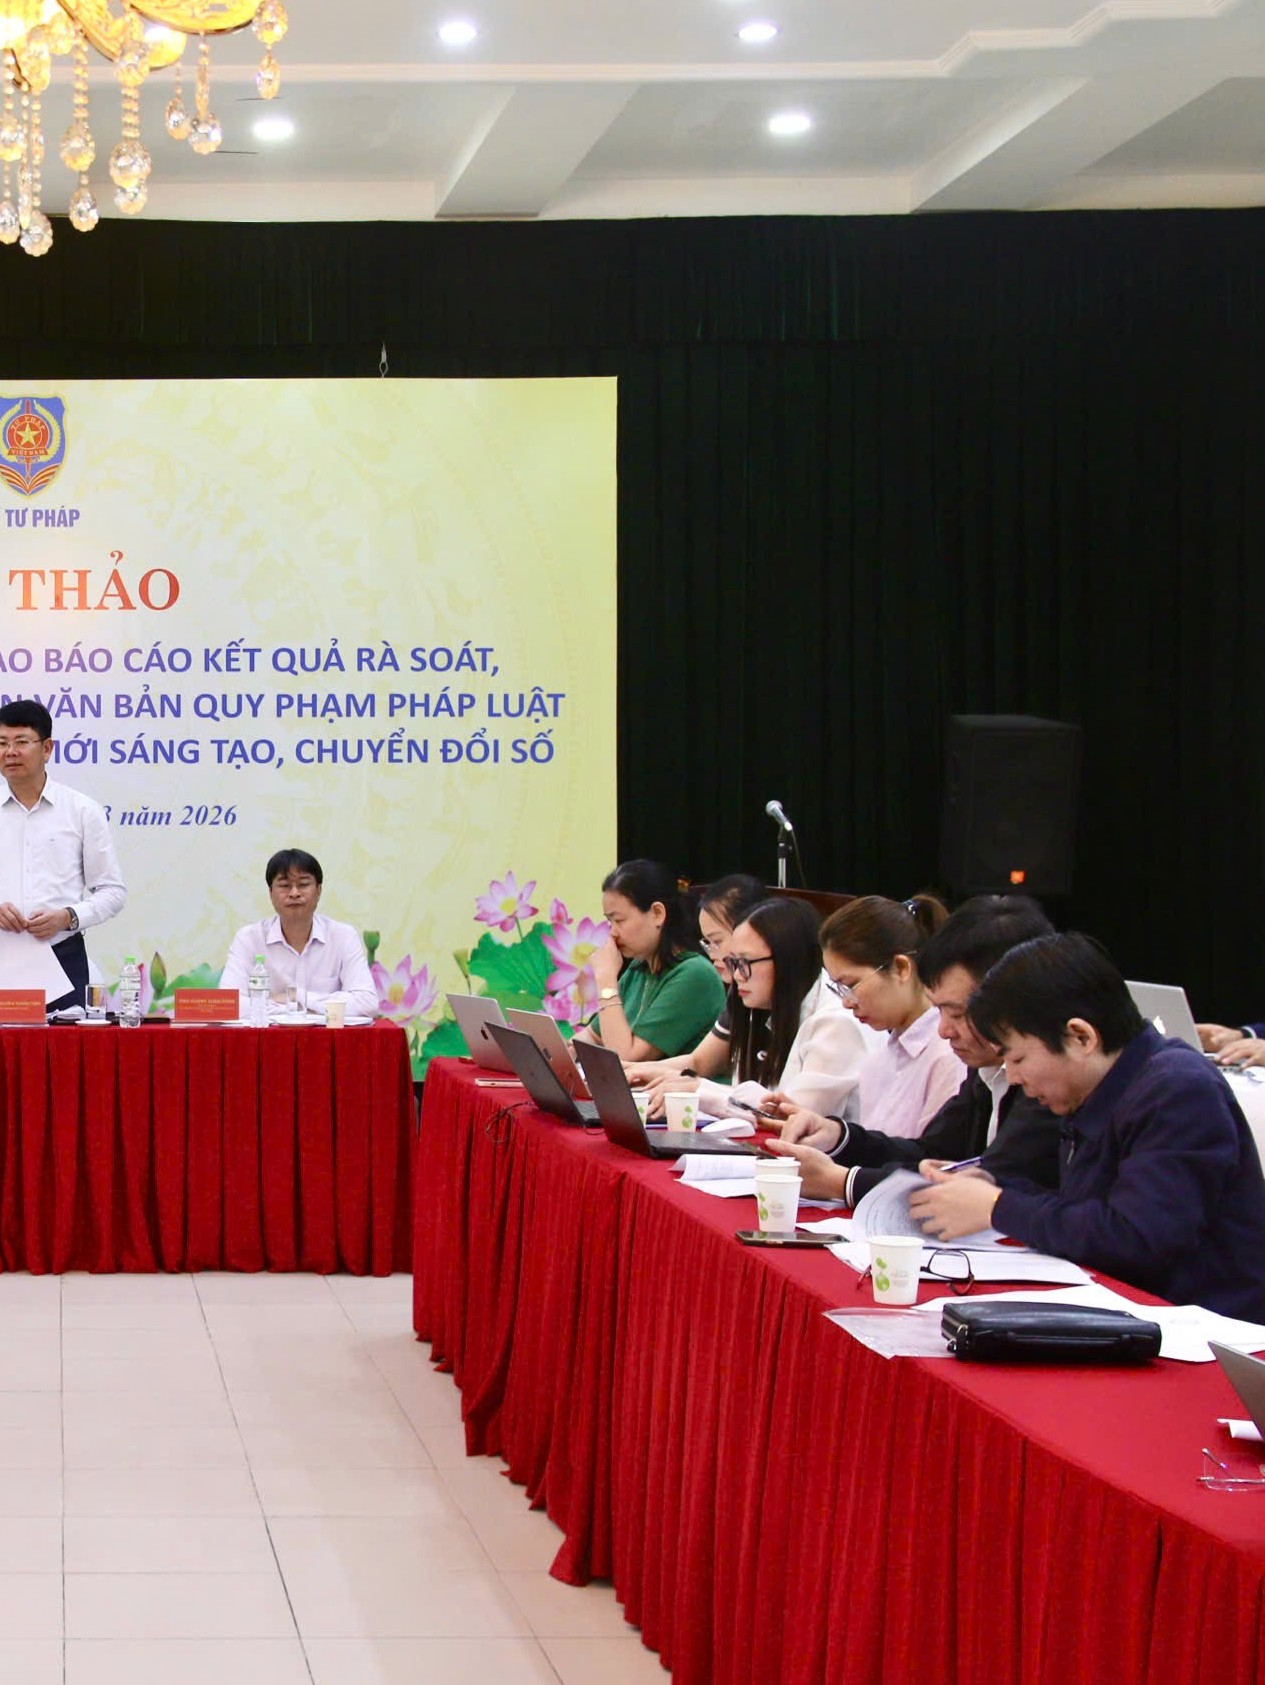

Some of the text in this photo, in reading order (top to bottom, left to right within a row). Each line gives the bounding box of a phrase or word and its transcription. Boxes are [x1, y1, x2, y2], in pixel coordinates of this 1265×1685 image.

[5, 507, 28, 527] TƯ
[32, 505, 80, 527] PHÁP
[9, 551, 180, 611] THẢO
[45, 641, 112, 673] BÁO
[124, 641, 192, 673] CÁO
[204, 638, 262, 673] KẾT
[272, 638, 345, 677] QUẢ
[357, 640, 400, 673] RÀ
[410, 640, 499, 677] SOÁT,
[115, 684, 181, 718] BẢN
[193, 693, 265, 722] QUY
[276, 693, 375, 724] PHẠM
[389, 686, 476, 718] PHÁP
[488, 686, 565, 724] LUẬT
[110, 733, 199, 764] SÁNG
[210, 739, 284, 770] TẠO,
[296, 727, 428, 764] CHUYỂN
[439, 727, 499, 764] ĐỔI
[511, 729, 554, 764] SỐ
[120, 805, 172, 826] năm
[180, 805, 237, 826] 2026
